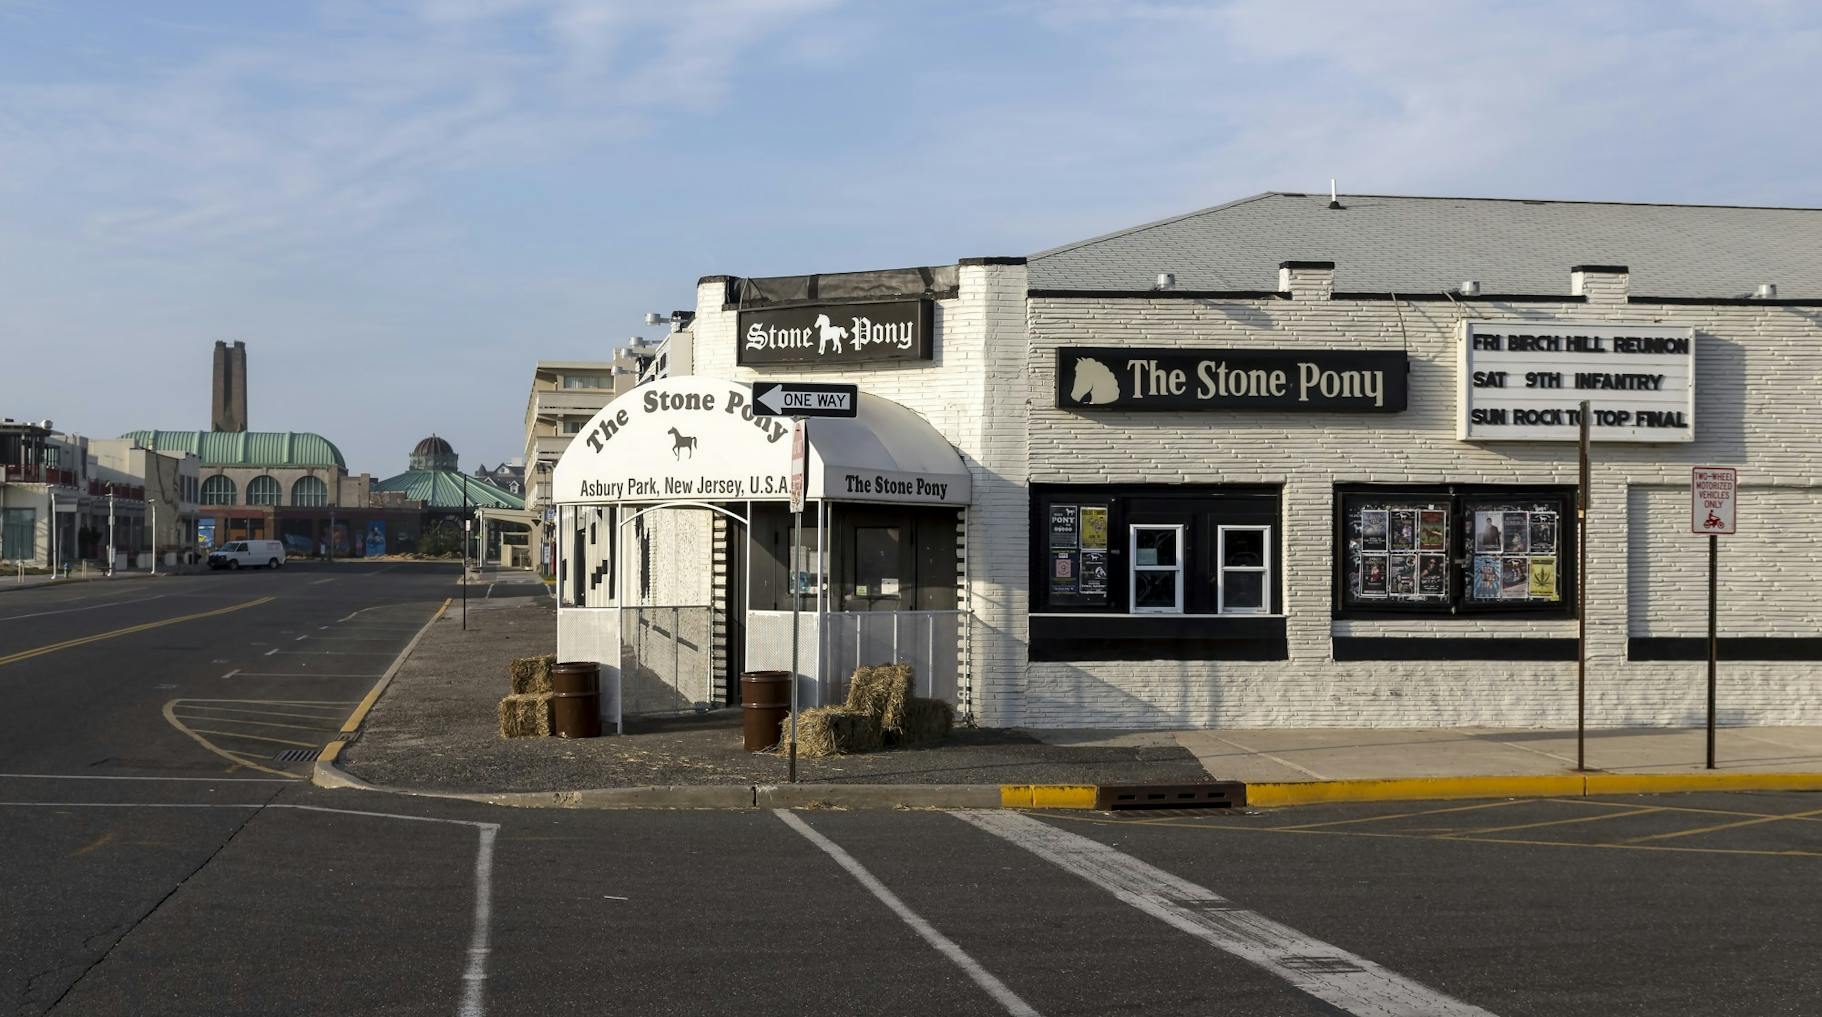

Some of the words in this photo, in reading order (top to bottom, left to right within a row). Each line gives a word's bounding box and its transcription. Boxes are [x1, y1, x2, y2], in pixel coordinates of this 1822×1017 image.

[746, 321, 814, 350] Stone
[850, 316, 913, 351] Pony
[1472, 333, 1500, 351] FRI
[1508, 334, 1559, 352] BIRCH
[1566, 335, 1606, 353] HILL
[1613, 336, 1689, 354] REUNION
[1127, 359, 1187, 399] The
[1197, 360, 1287, 400] Stone
[1297, 362, 1384, 407] Pony
[1472, 371, 1507, 388] SAT
[1525, 371, 1561, 389] 9TH
[1575, 372, 1664, 391] INFANTRY
[784, 393, 812, 407] ONE
[817, 394, 846, 407] WAY
[586, 408, 629, 454] The
[643, 389, 715, 414] Stone
[725, 390, 789, 443] Pony
[1471, 408, 1506, 426] SUN
[1513, 408, 1562, 426] ROCK
[1593, 409, 1631, 427] TOP
[1636, 411, 1688, 428] FINAL
[1695, 472, 1733, 481] TWO-WHEEL
[1696, 481, 1732, 490] MOTORIZED
[580, 479, 624, 499] Asbury
[628, 477, 660, 497] Park,
[664, 476, 693, 494] New
[697, 476, 745, 498] Jersey,
[845, 474, 871, 494] The
[875, 475, 912, 495] Stone
[916, 478, 948, 500] Pony
[1699, 491, 1730, 499] VEHICLES
[1704, 500, 1724, 508] ONLY
